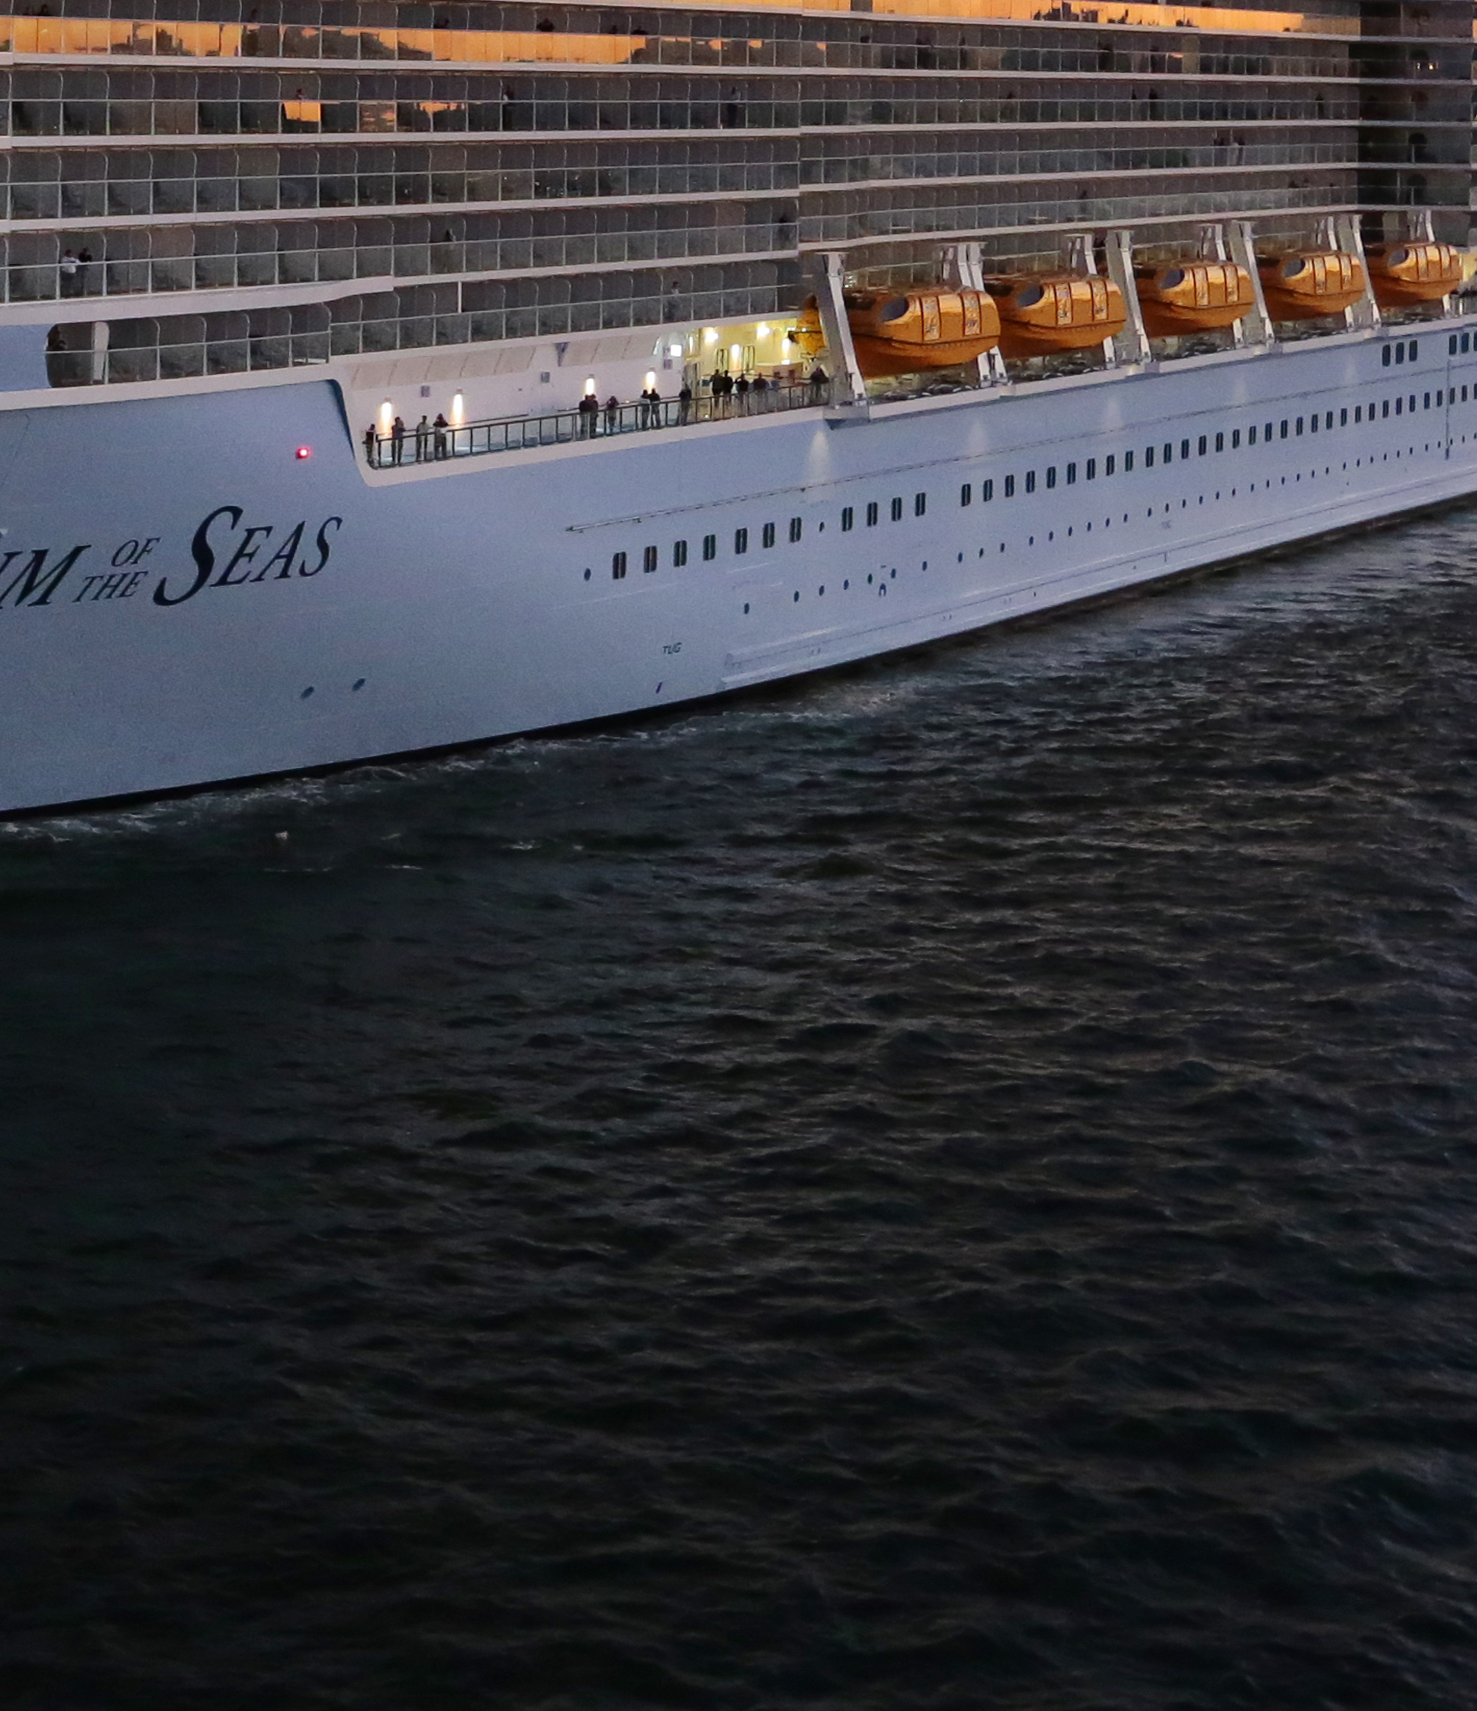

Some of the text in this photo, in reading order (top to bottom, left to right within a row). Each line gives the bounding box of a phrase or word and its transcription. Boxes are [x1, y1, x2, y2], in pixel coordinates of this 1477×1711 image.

[111, 537, 162, 567] OF
[153, 505, 343, 606] SEAS
[72, 571, 149, 603] THE
[662, 642, 682, 655] TUG
